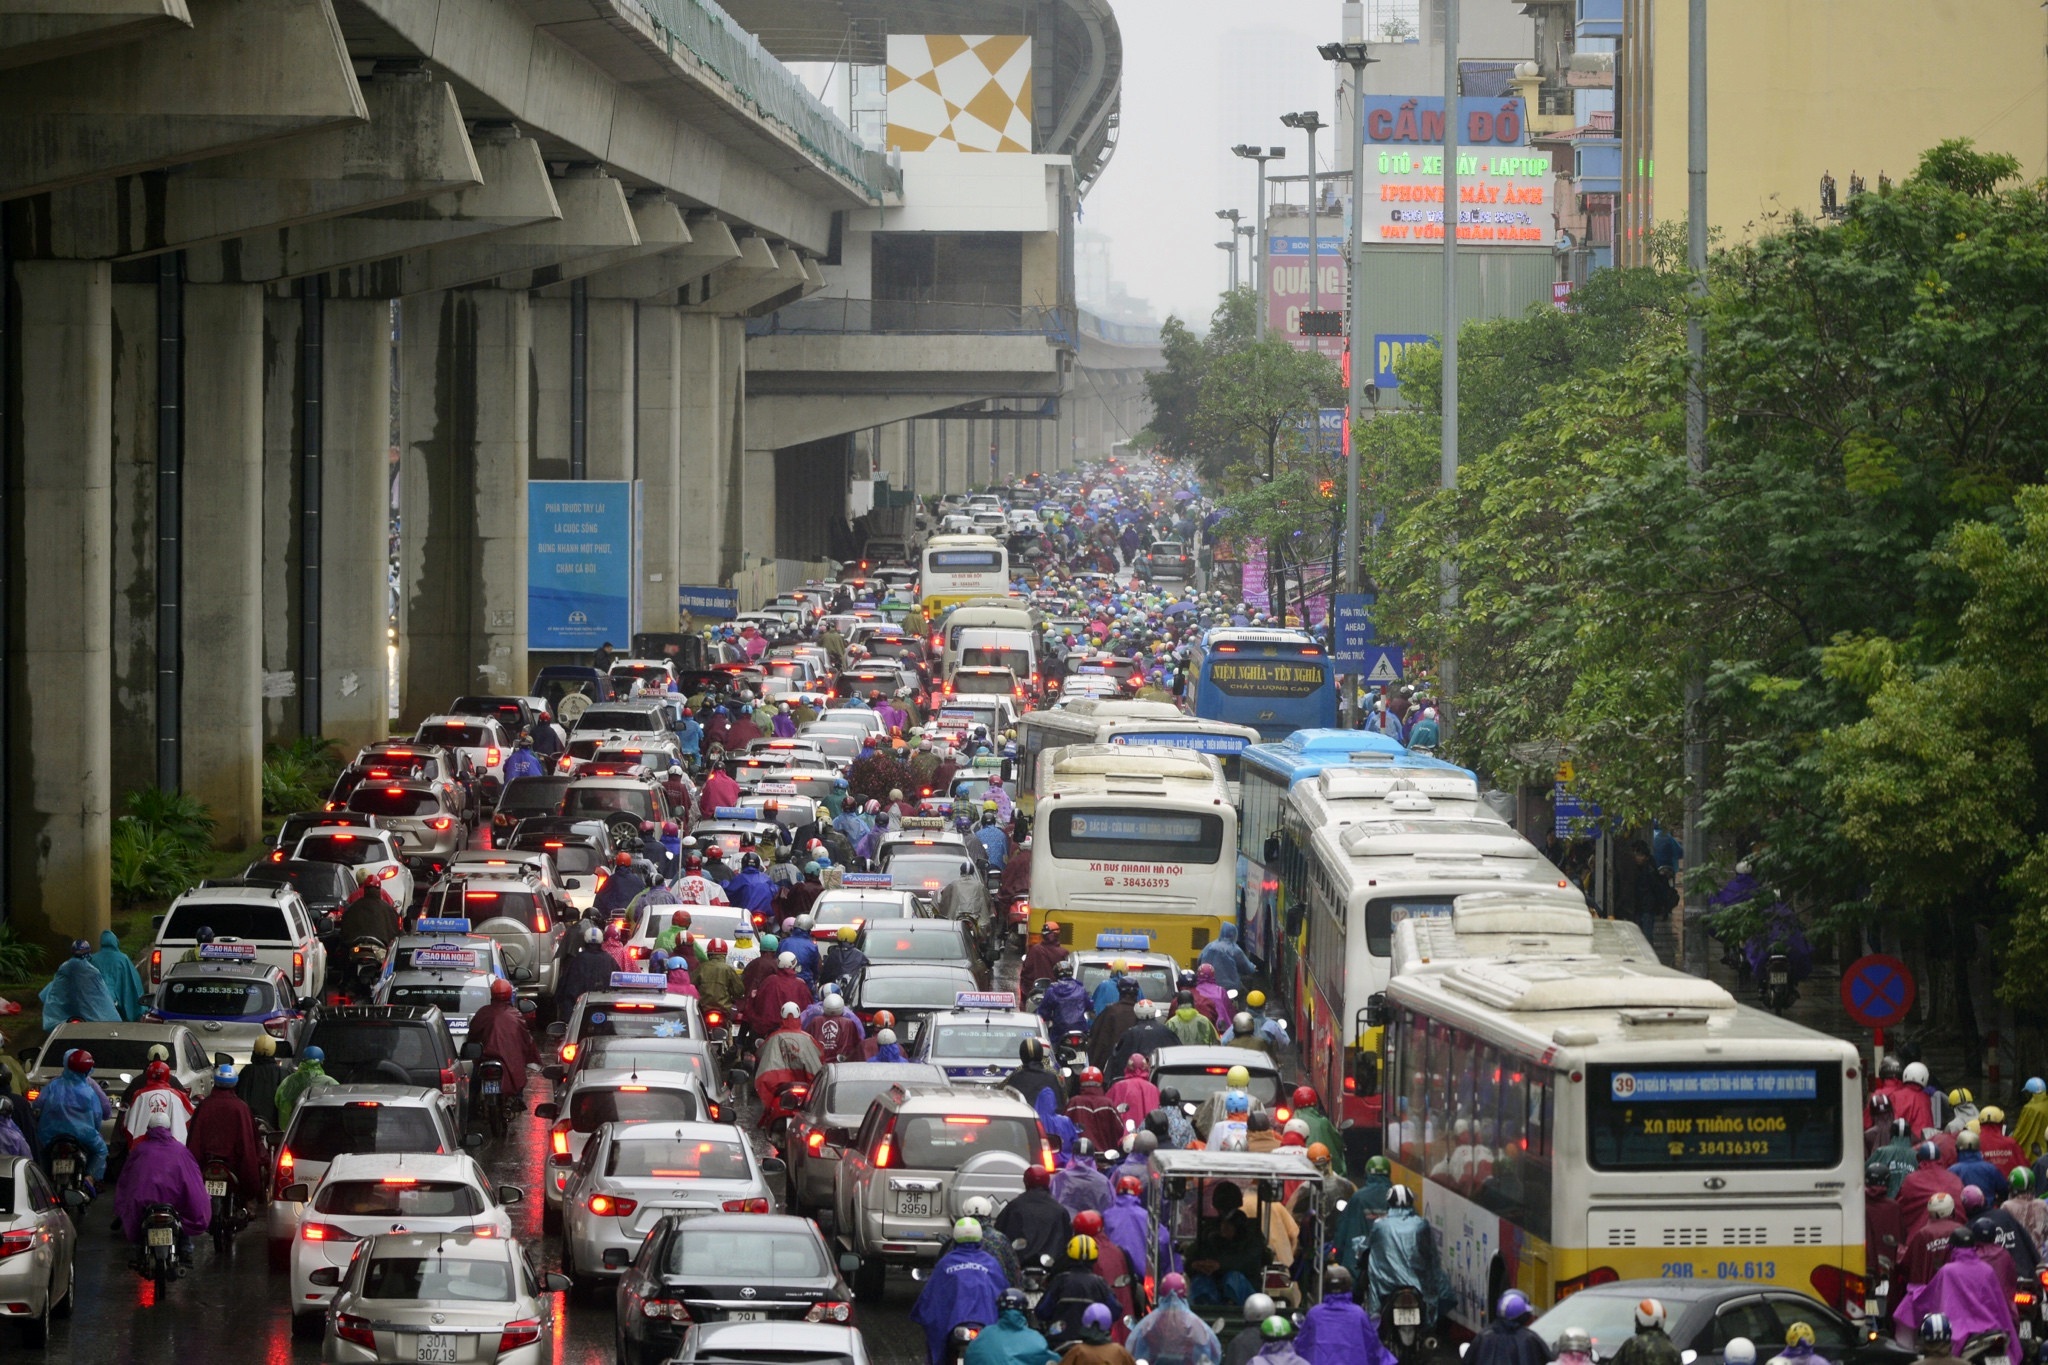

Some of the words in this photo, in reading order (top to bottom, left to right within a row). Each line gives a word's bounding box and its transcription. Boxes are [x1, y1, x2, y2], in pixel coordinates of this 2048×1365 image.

[1468, 100, 1520, 142] ĐỒ
[1422, 156, 1442, 174] XE
[1456, 153, 1478, 175] ÁY
[1490, 157, 1548, 176] LAPTOP
[1381, 226, 1409, 238] VAY
[1345, 623, 1365, 631] AHEAD
[1214, 664, 1236, 681] NIỆM
[1239, 665, 1267, 680] NGHĨA
[1294, 667, 1322, 683] NGHĨA
[1072, 821, 1085, 831] 02
[1090, 863, 1101, 871] XN
[1104, 863, 1119, 872] BUS
[1121, 864, 1150, 873] NHANH
[1153, 864, 1164, 874] HÀ
[1166, 864, 1182, 876] NỘI
[1123, 878, 1169, 888] 38436393
[1616, 1077, 1634, 1092] 39
[1644, 1119, 1663, 1133] XN
[1667, 1119, 1691, 1132] BUS
[1696, 1115, 1744, 1132] THĂNG
[1748, 1117, 1786, 1131] LONG
[1699, 1141, 1768, 1155] 38436393
[906, 1193, 922, 1203] 31F
[901, 1203, 927, 1214] 3959
[1662, 1263, 1693, 1278] 29B
[1718, 1262, 1775, 1278] 04.613
[427, 1336, 447, 1348] 30A
[419, 1349, 455, 1360] 307.19
